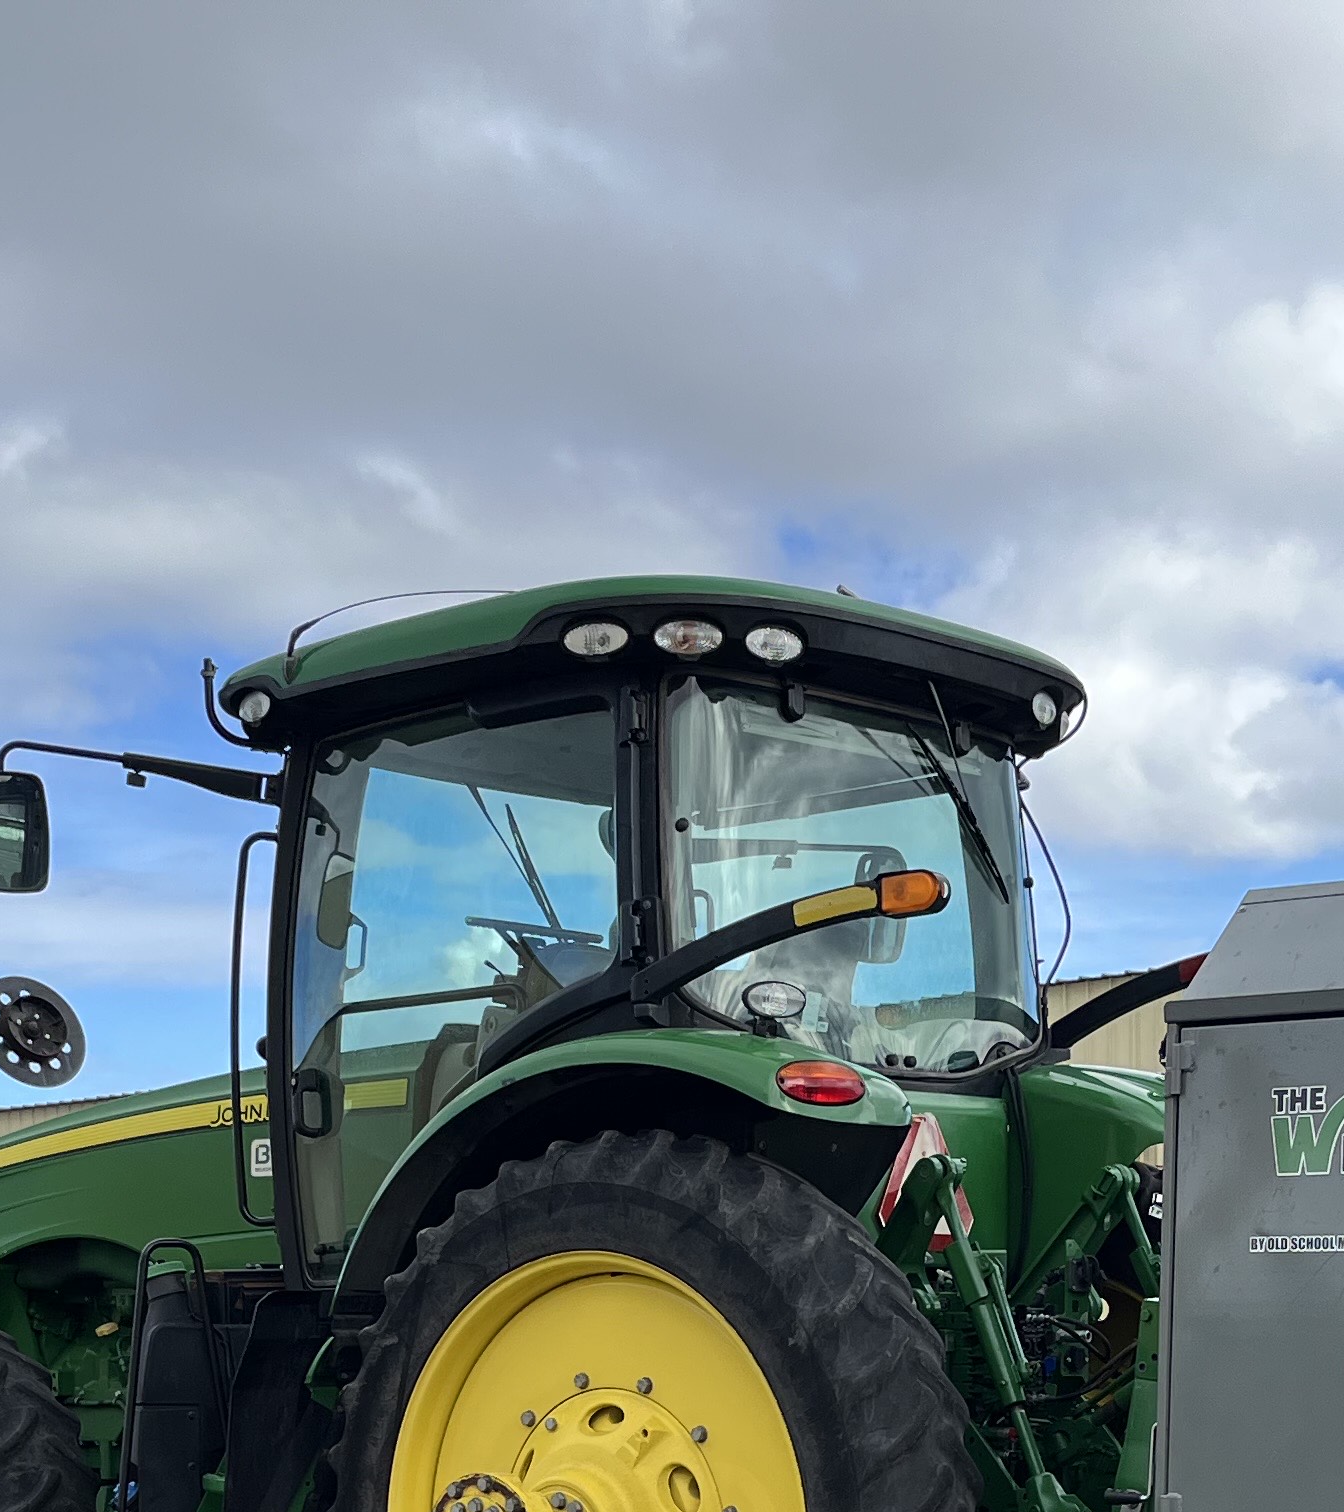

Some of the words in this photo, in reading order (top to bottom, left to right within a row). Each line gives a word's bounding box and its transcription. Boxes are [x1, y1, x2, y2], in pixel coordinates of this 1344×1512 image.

[1272, 1086, 1327, 1115] THE
[1250, 1236, 1266, 1252] BY
[1266, 1236, 1289, 1252] OLD
[1290, 1235, 1336, 1252] SCHOOL
